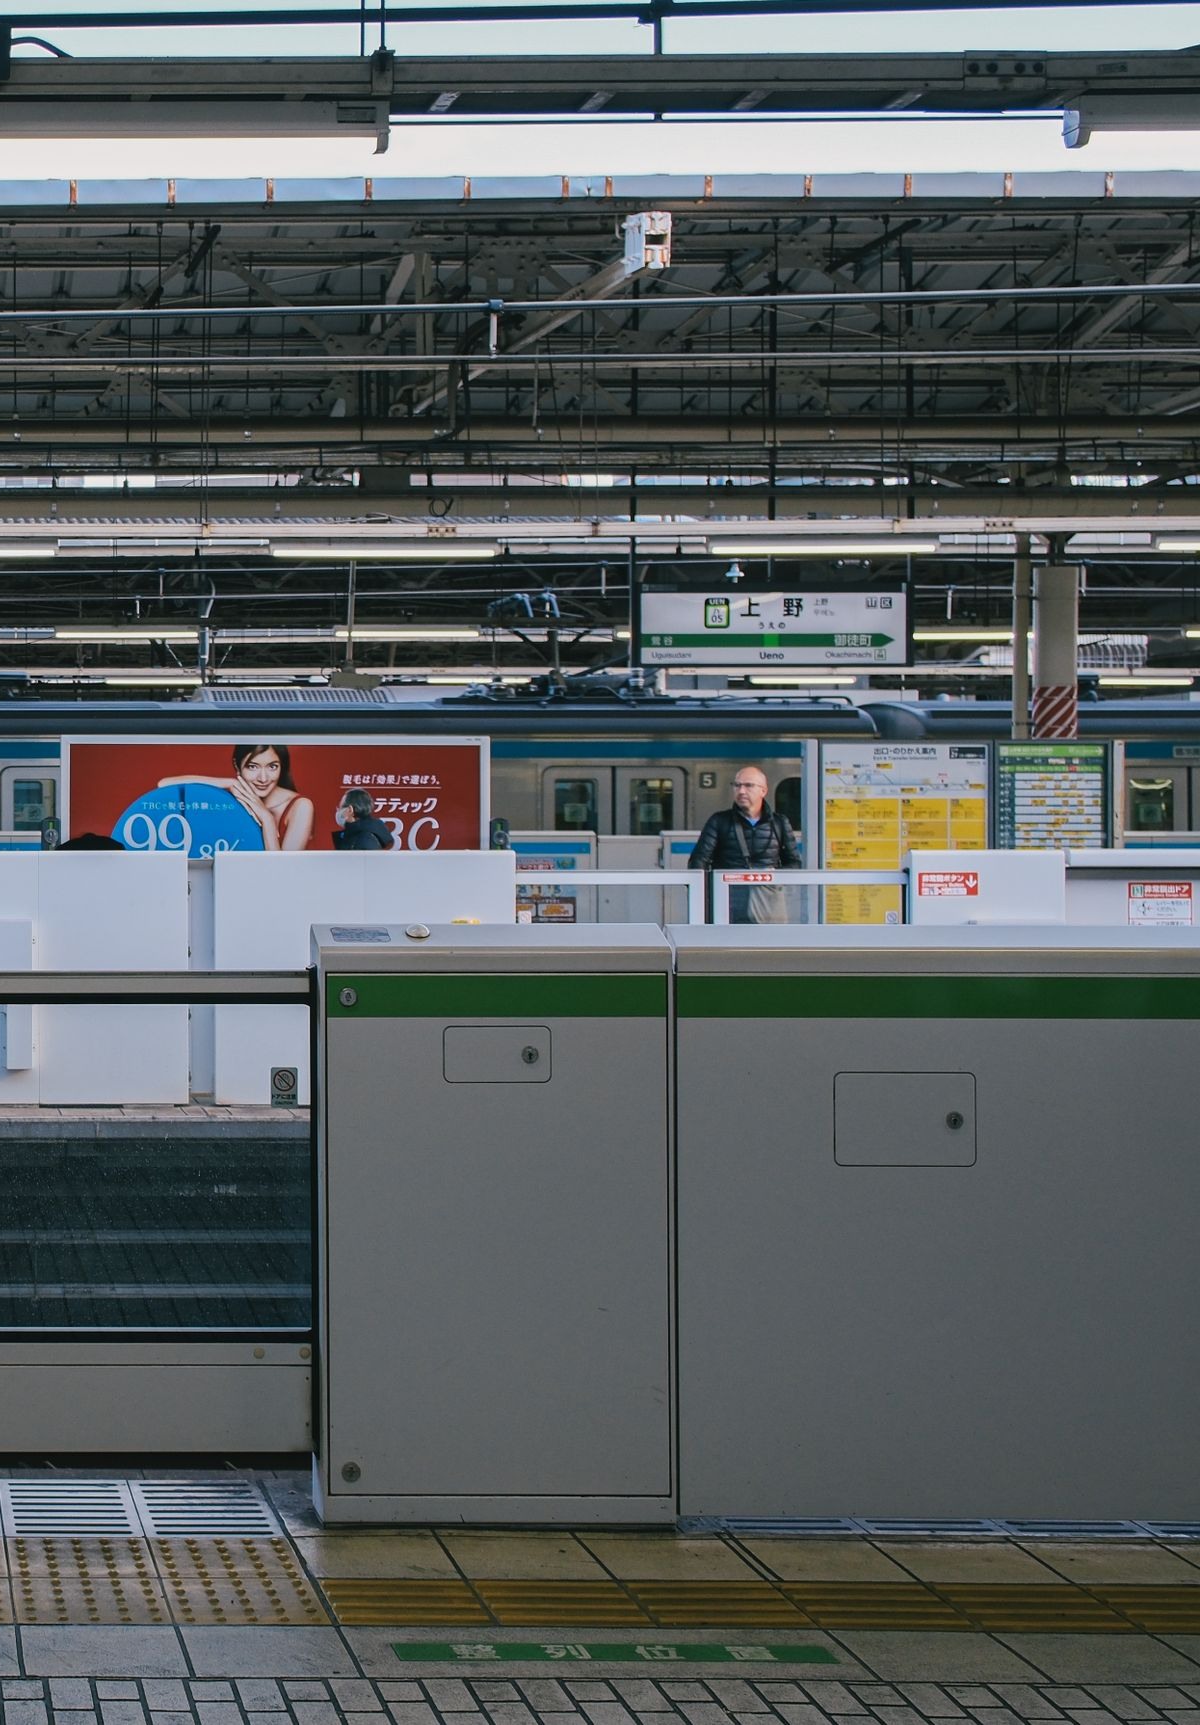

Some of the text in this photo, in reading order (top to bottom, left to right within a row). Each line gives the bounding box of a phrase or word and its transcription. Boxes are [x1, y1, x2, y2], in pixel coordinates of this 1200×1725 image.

[740, 597, 803, 617] 上野
[866, 597, 892, 609] 山 区
[711, 614, 723, 623] 05
[759, 621, 786, 630] うえの
[834, 634, 872, 647] 御徒町
[343, 774, 440, 785] 脱毛は「効果」で選ぼう。
[703, 774, 712, 787] 5
[449, 1644, 779, 1660] 整列位置
